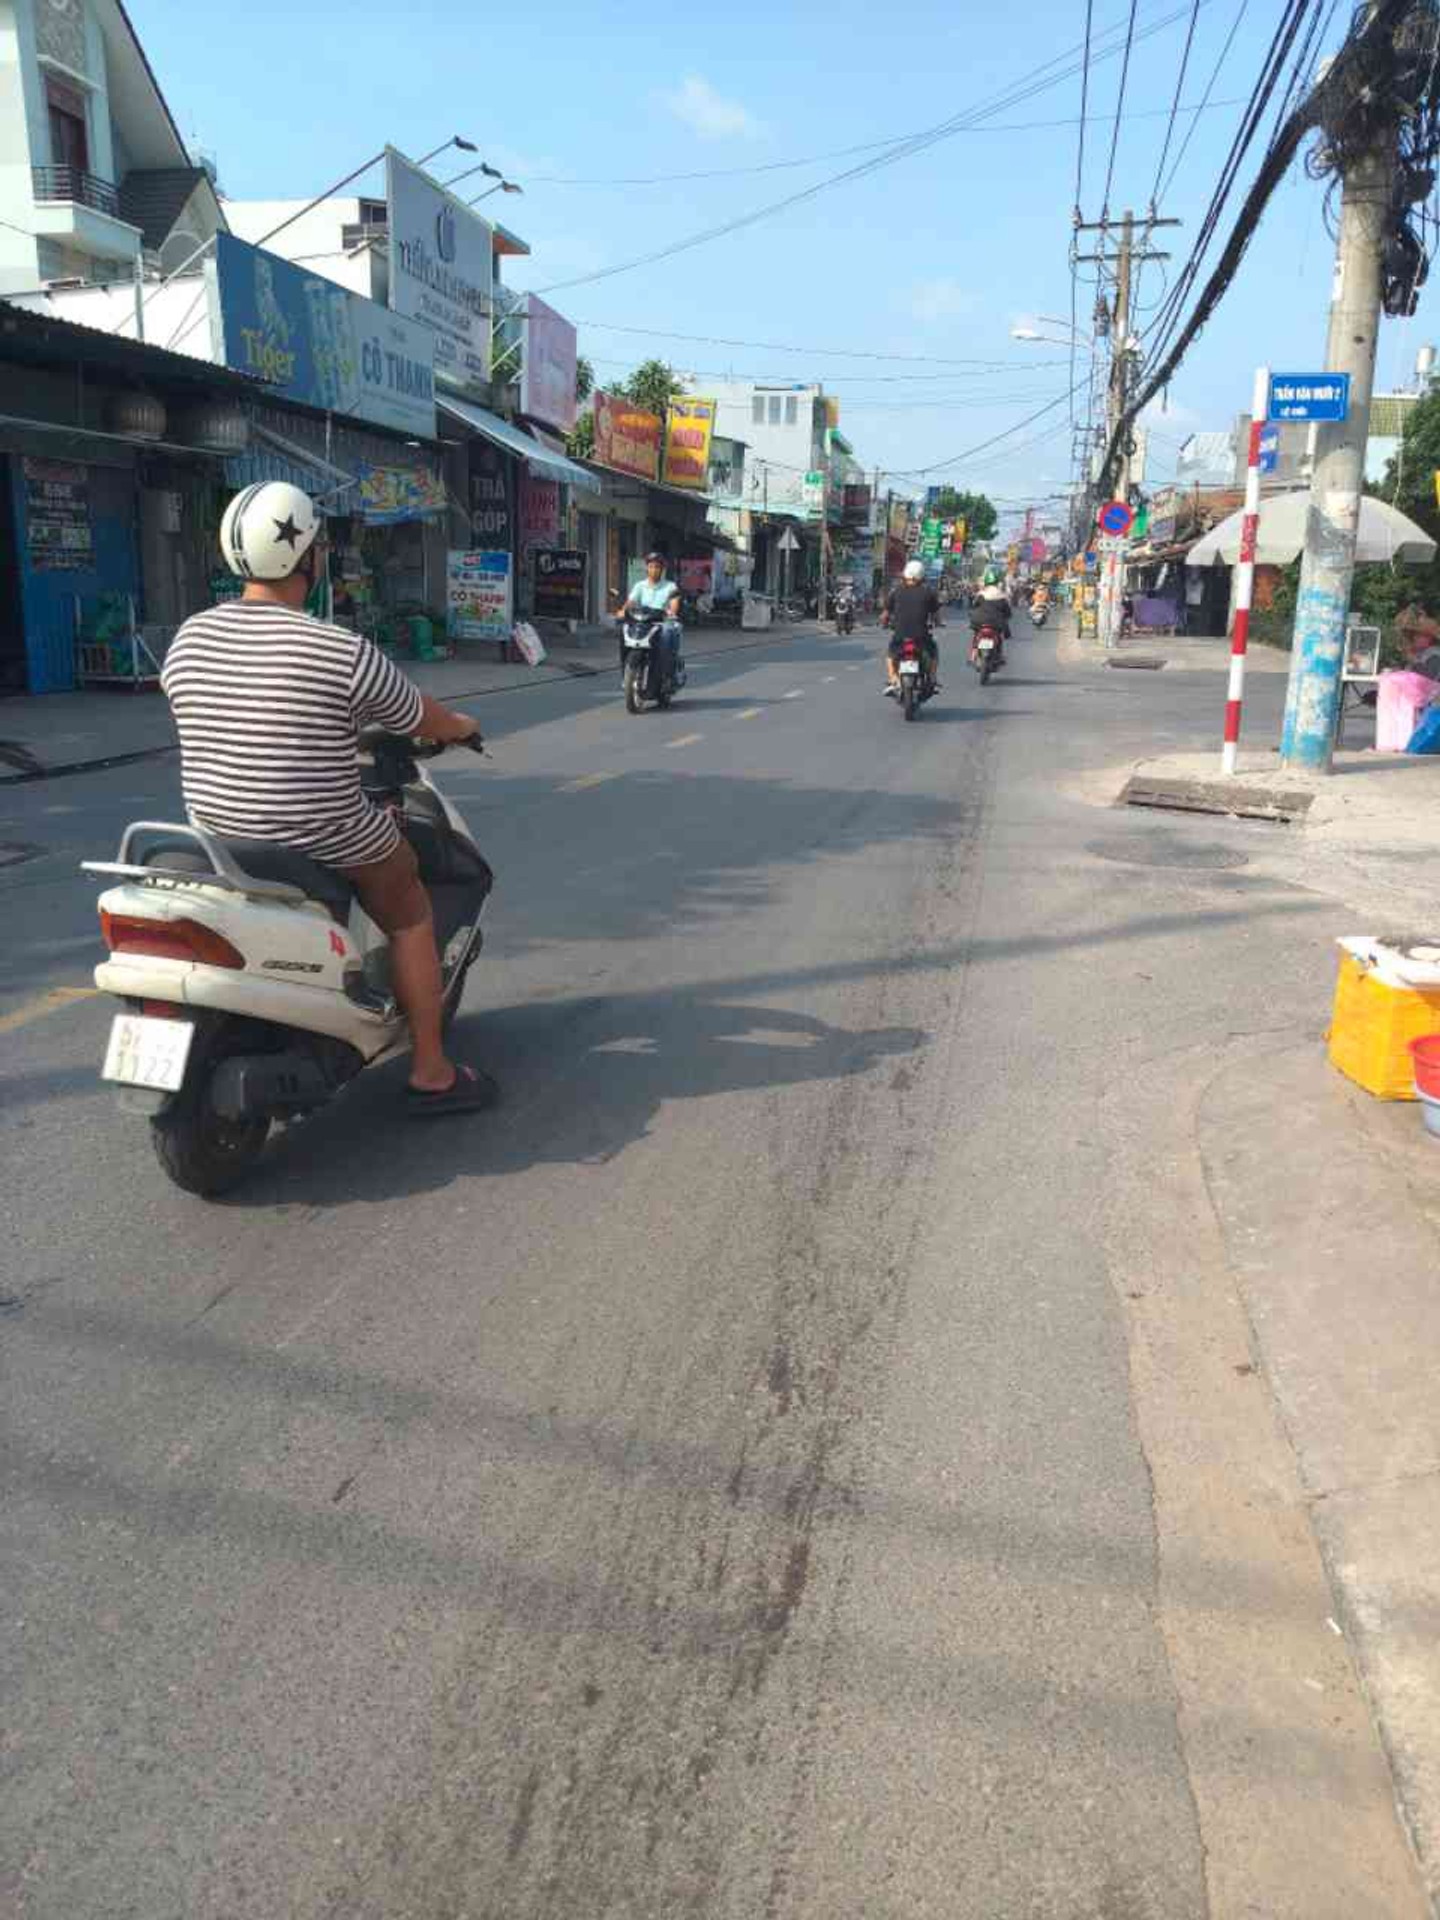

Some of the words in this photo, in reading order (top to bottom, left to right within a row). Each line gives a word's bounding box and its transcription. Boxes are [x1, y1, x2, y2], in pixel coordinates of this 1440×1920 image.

[239, 326, 295, 383] Tiger
[362, 336, 383, 384] CÔ
[384, 351, 433, 399] THANH
[472, 503, 507, 532] GÓP
